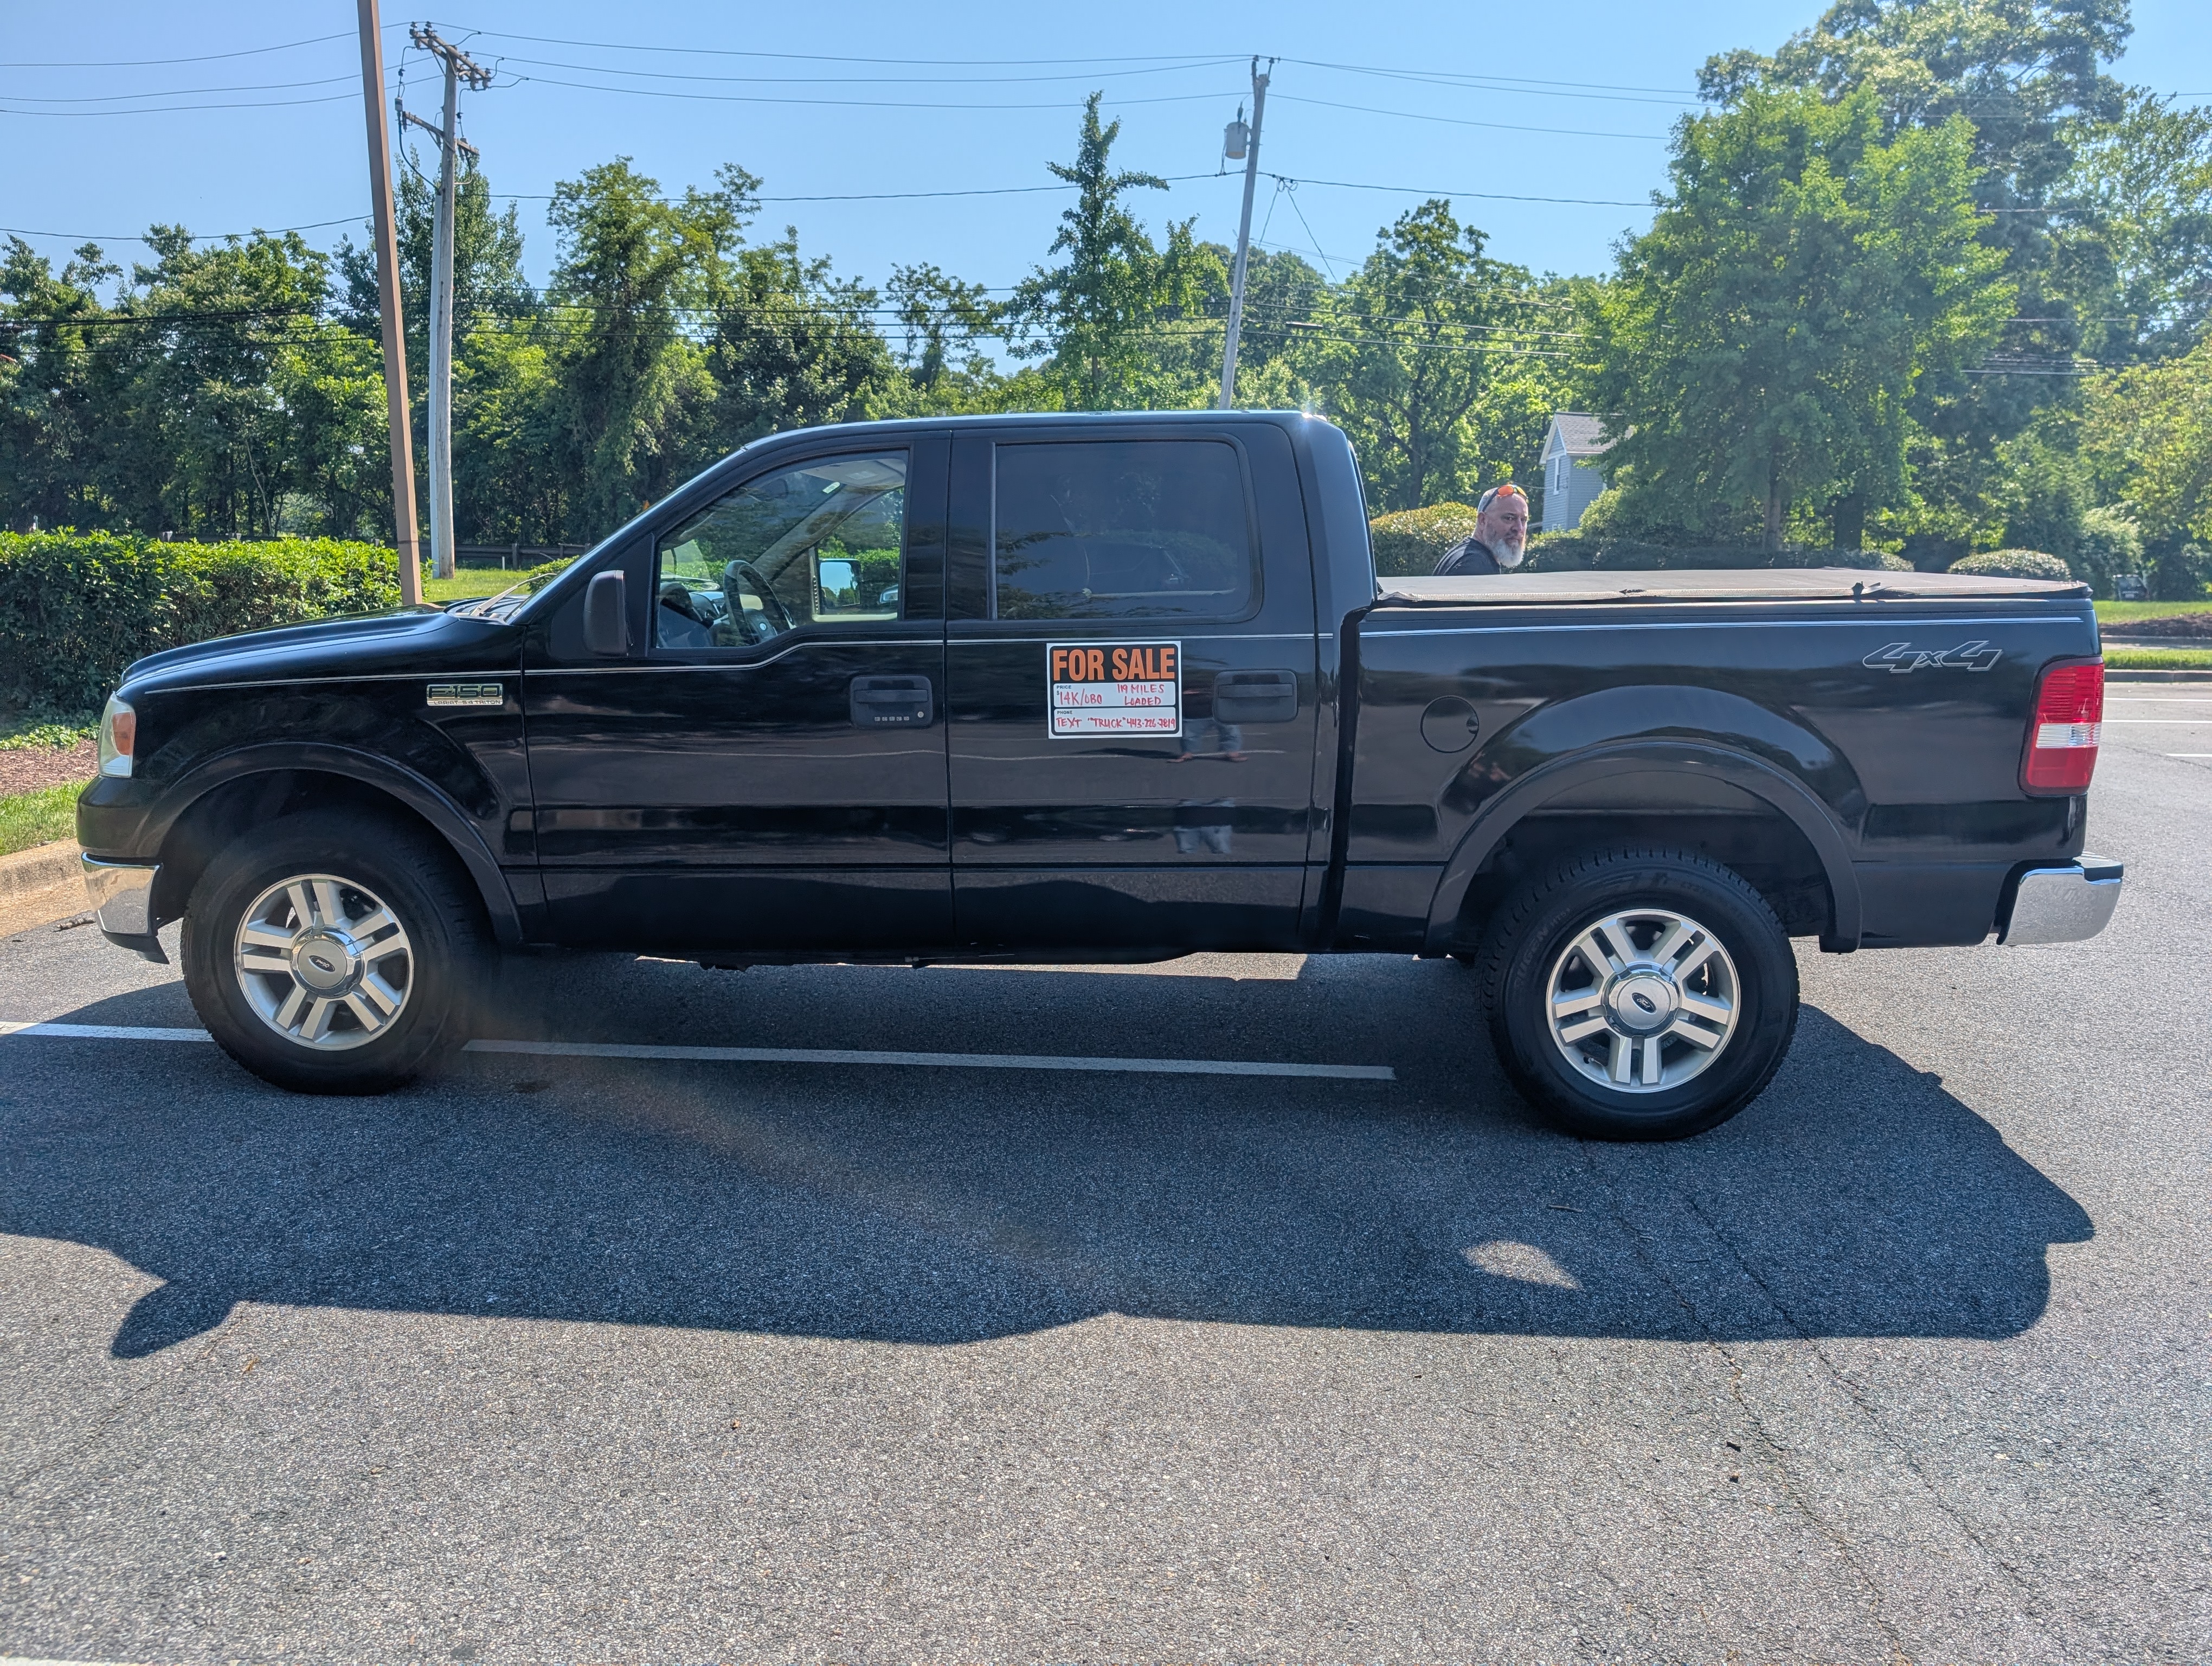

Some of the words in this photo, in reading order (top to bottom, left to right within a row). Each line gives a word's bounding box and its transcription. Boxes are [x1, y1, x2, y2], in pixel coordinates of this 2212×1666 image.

[1862, 640, 2003, 673] 4x4
[1053, 649, 1105, 681] FOR
[1112, 648, 1175, 680] SALE
[428, 685, 500, 699] F-150
[1130, 684, 1165, 695] MILES
[1124, 696, 1161, 706] LOADED
[1056, 717, 1082, 729] TEXT
